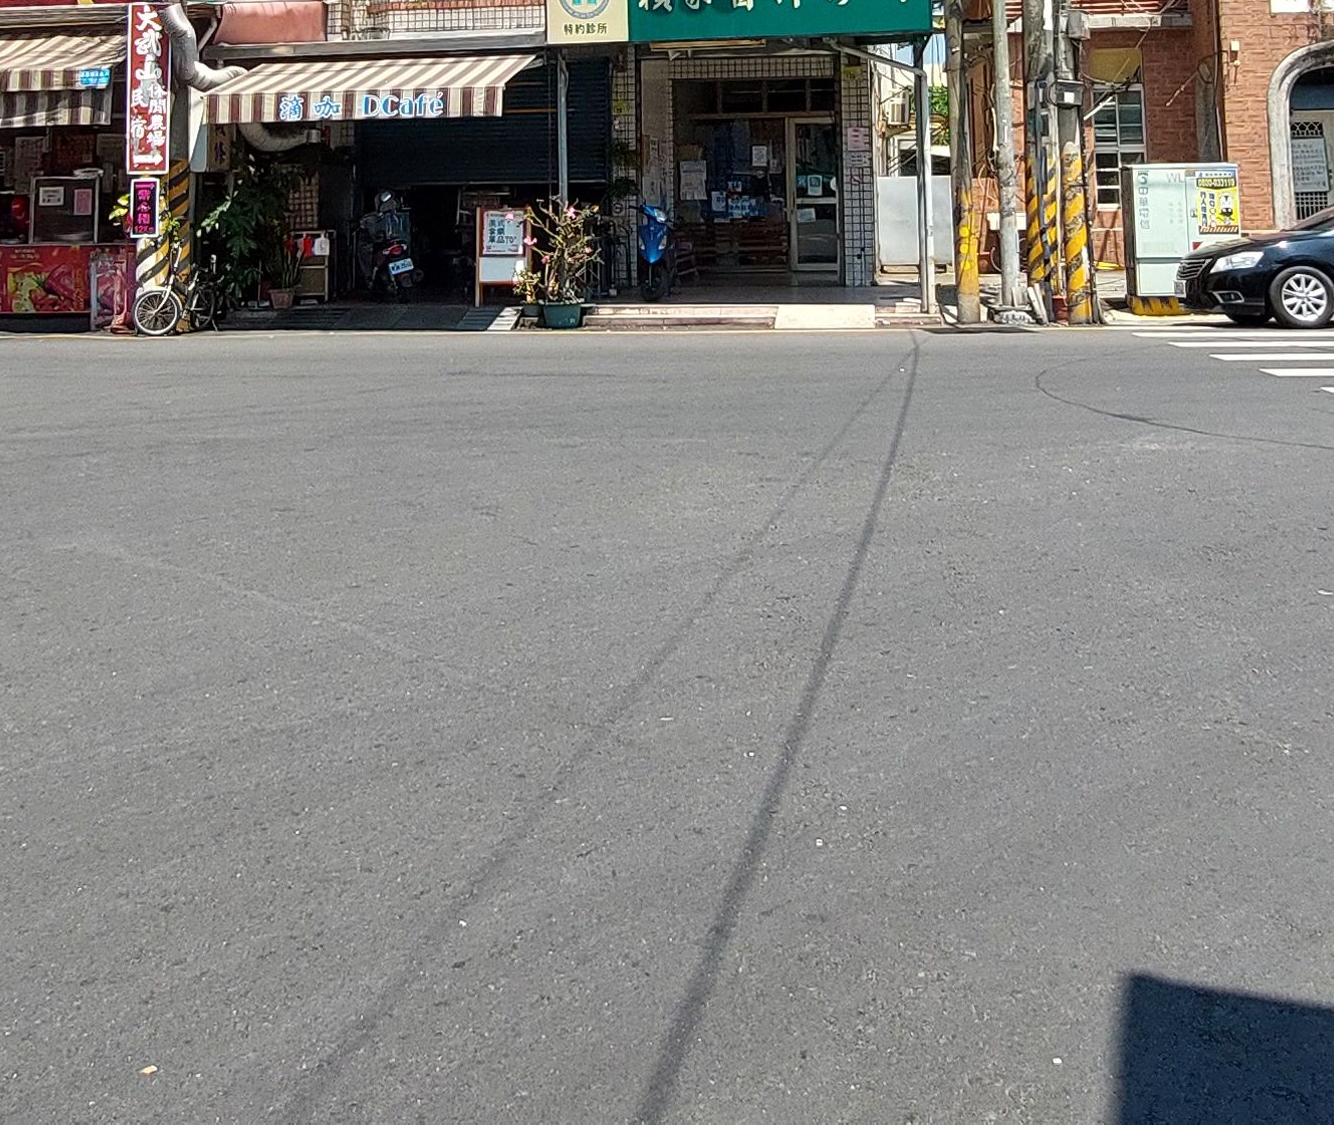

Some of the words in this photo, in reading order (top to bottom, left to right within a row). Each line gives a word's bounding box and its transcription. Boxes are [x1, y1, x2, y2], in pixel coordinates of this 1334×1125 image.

[564, 22, 608, 35] 特約診所
[134, 4, 163, 81] 大武山
[362, 91, 445, 118] DCafé
